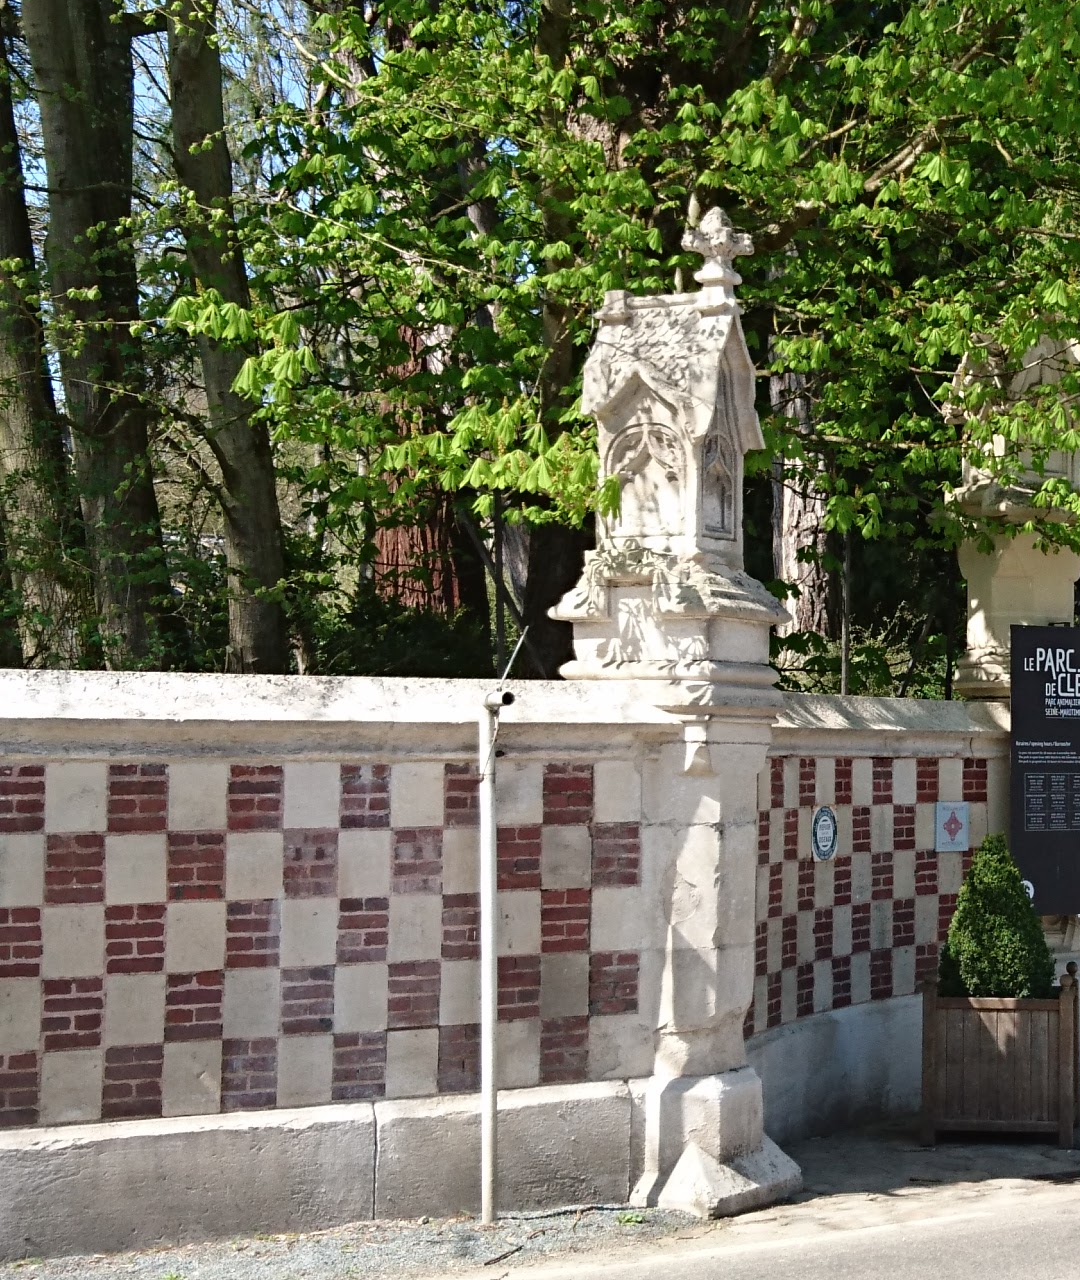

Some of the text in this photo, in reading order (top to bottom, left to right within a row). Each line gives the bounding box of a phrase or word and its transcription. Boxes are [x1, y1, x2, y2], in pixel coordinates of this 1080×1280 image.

[1024, 647, 1077, 680] LE PARC
[1045, 682, 1057, 697] DE
[1045, 698, 1057, 708] PARC
[1057, 698, 1080, 708] ANIMALIER
